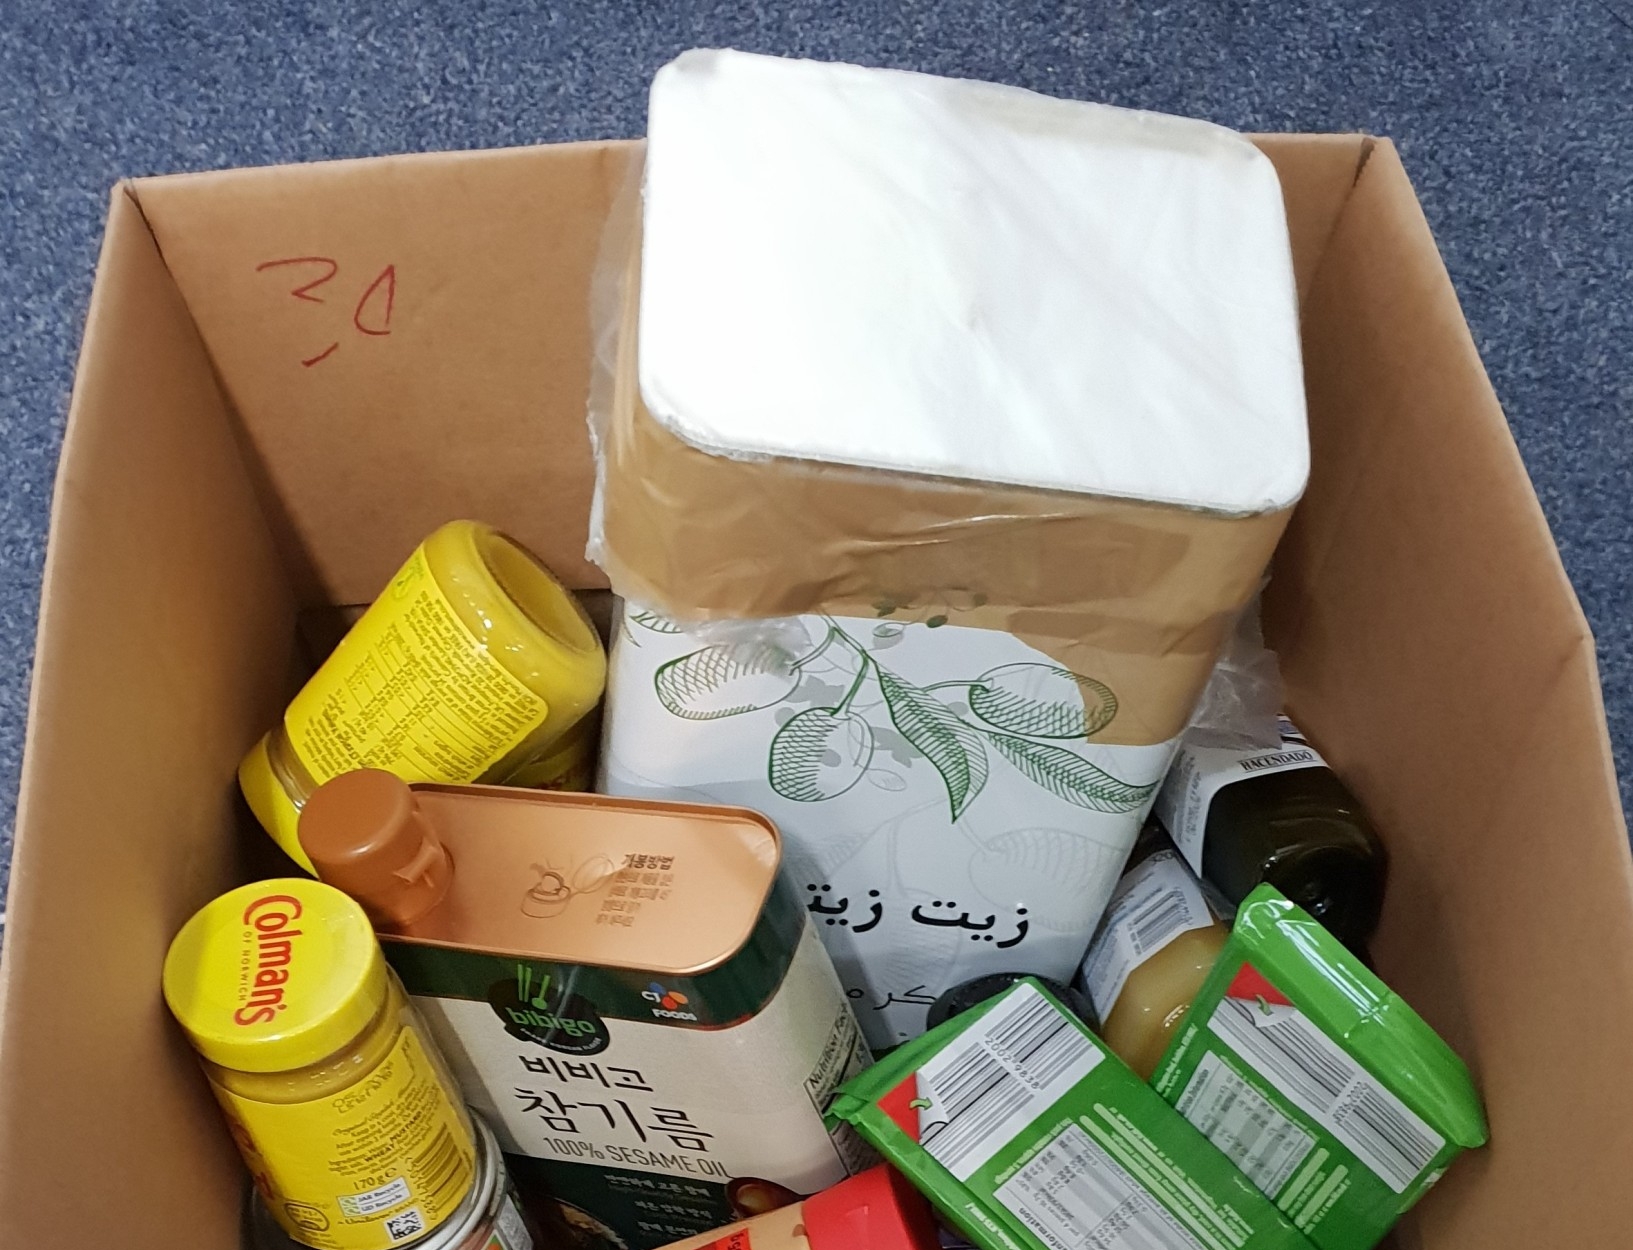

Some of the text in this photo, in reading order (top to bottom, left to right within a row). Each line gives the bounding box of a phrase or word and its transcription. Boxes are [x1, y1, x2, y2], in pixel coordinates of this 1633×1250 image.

[1241, 750, 1314, 771] HACENDADO
[911, 900, 1029, 949] زيت
[234, 894, 303, 1026] Colman's
[237, 930, 253, 1002] OF NORWICH
[505, 1006, 597, 1038] bibigo
[651, 1008, 698, 1022] FOODS
[518, 1055, 654, 1092] 비비고
[513, 1086, 715, 1152] 참기름
[543, 1137, 733, 1178] 100% SESAME OIL
